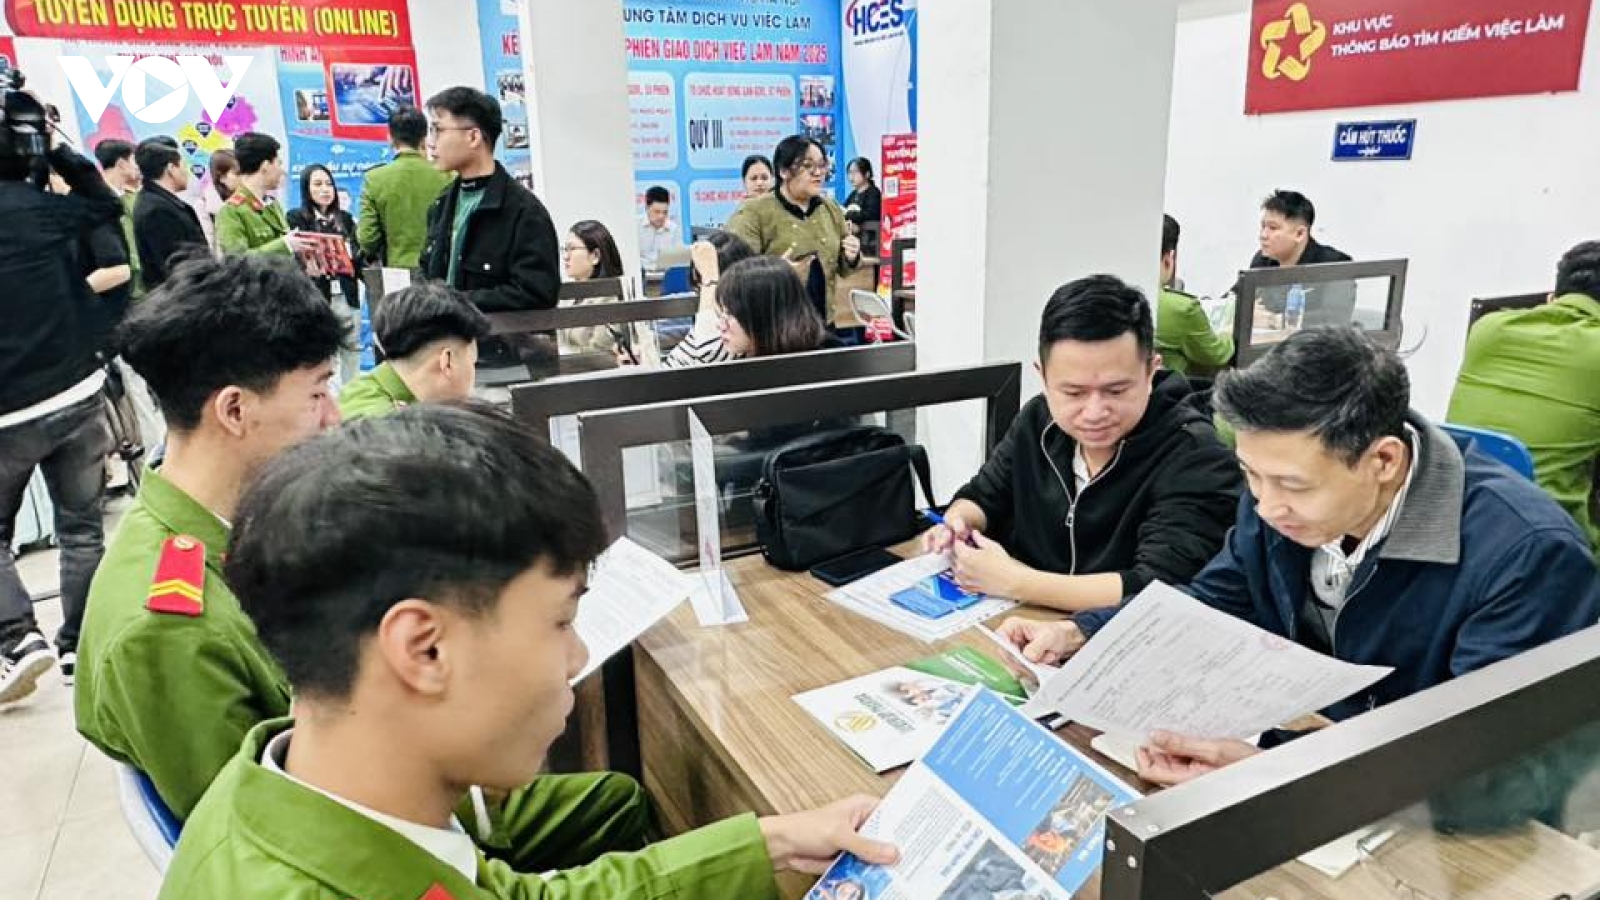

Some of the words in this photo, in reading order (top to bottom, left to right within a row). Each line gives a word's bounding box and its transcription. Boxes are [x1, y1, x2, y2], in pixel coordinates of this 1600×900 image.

[114, 1, 178, 34] DỤNG
[181, 3, 238, 36] TRỰC
[314, 7, 399, 38] (ONLINE)
[853, 0, 904, 35] HCES
[1331, 39, 1376, 57] THÔNG
[1380, 33, 1410, 51] BÁO
[1413, 29, 1439, 47] TÌM
[1442, 22, 1481, 43] KIẾM
[1484, 18, 1523, 40] VIỆC
[1524, 12, 1565, 34] LÀM
[1333, 19, 1360, 36] KHU
[1364, 13, 1393, 33] VỰC
